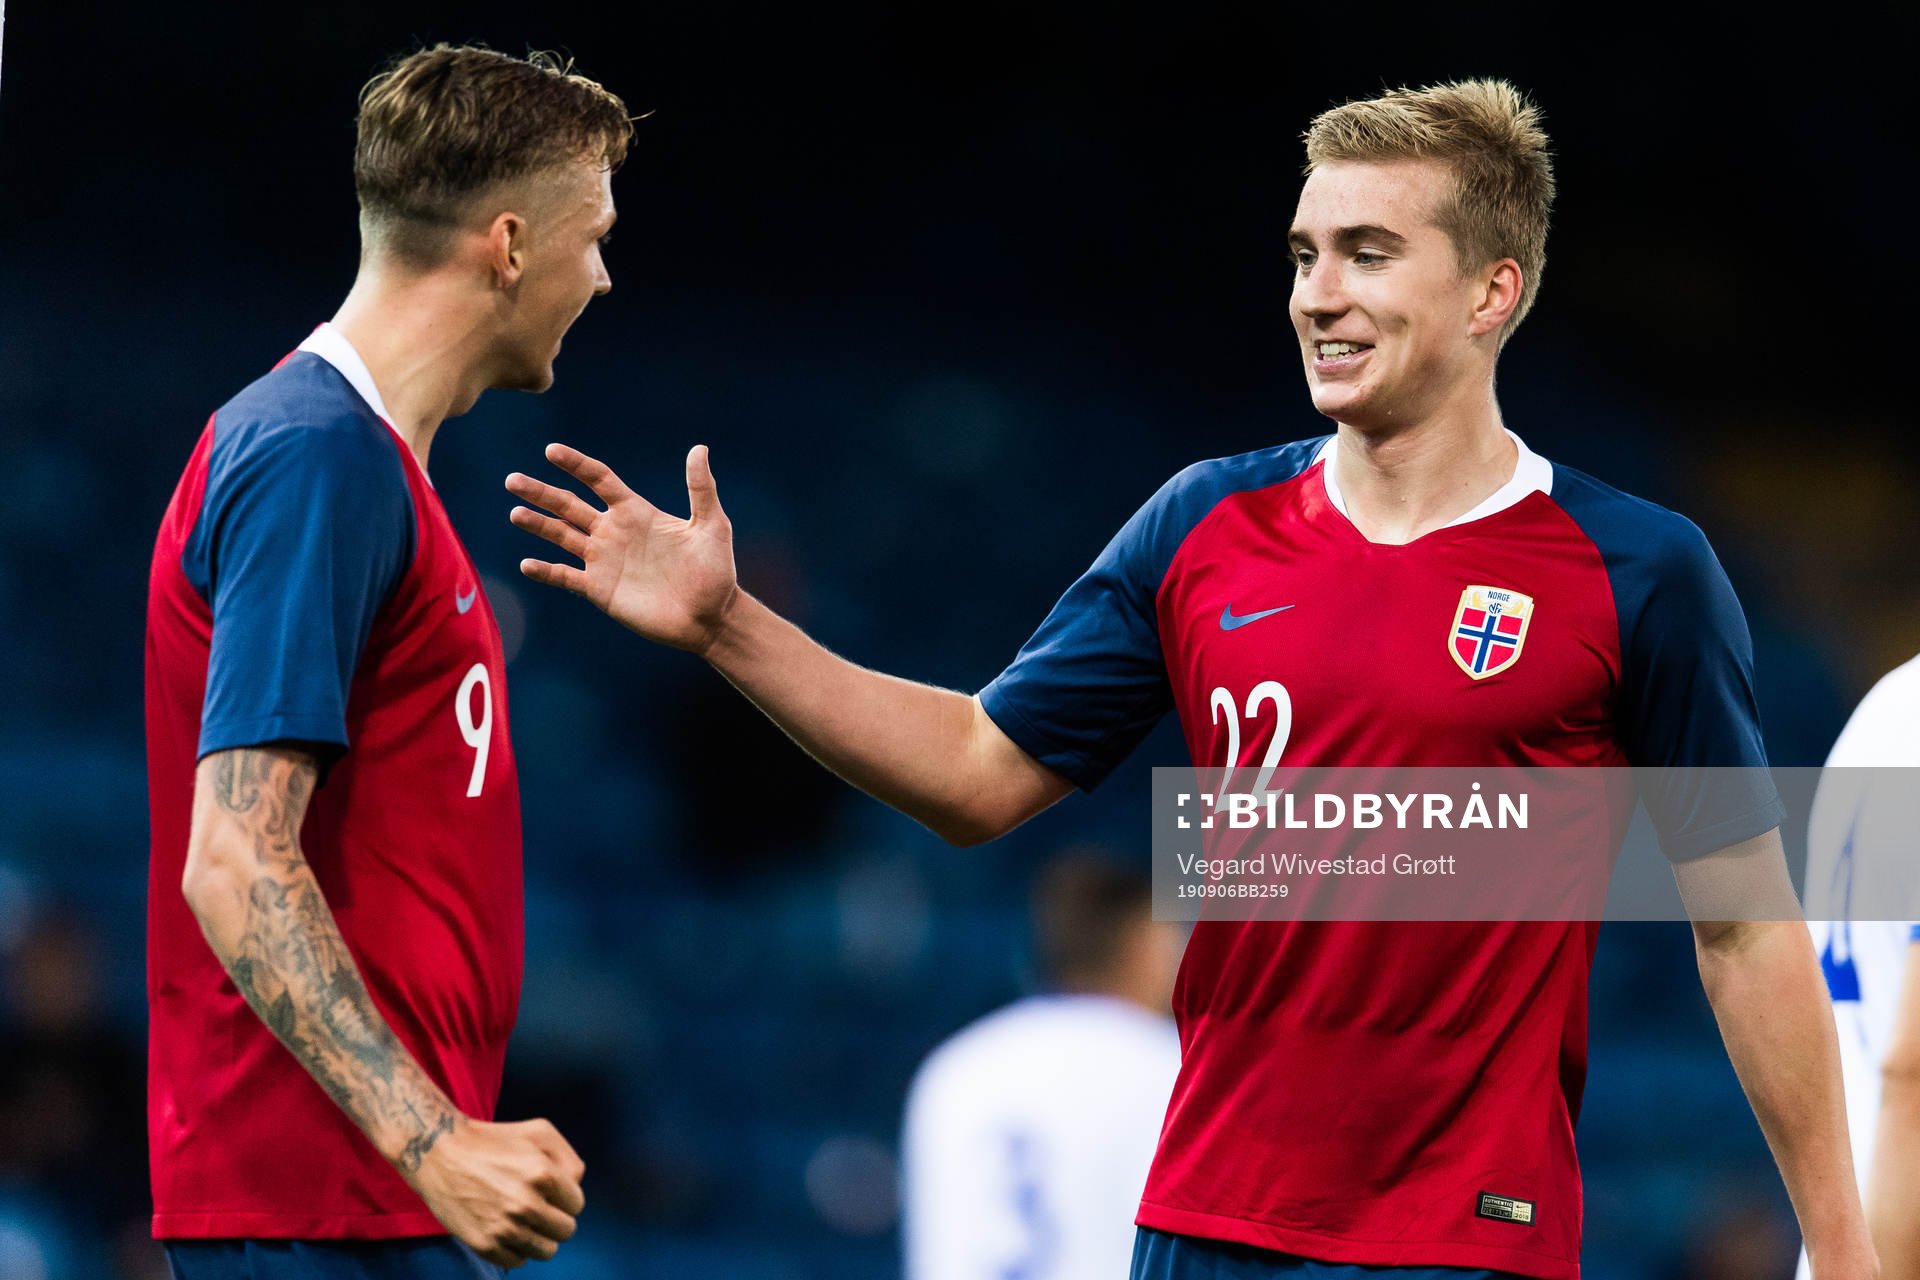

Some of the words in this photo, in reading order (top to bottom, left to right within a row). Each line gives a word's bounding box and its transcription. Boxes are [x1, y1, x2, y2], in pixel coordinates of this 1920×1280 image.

[1488, 590, 1510, 602] NORGE
[455, 663, 493, 798] 9
[1210, 681, 1293, 815] 22
